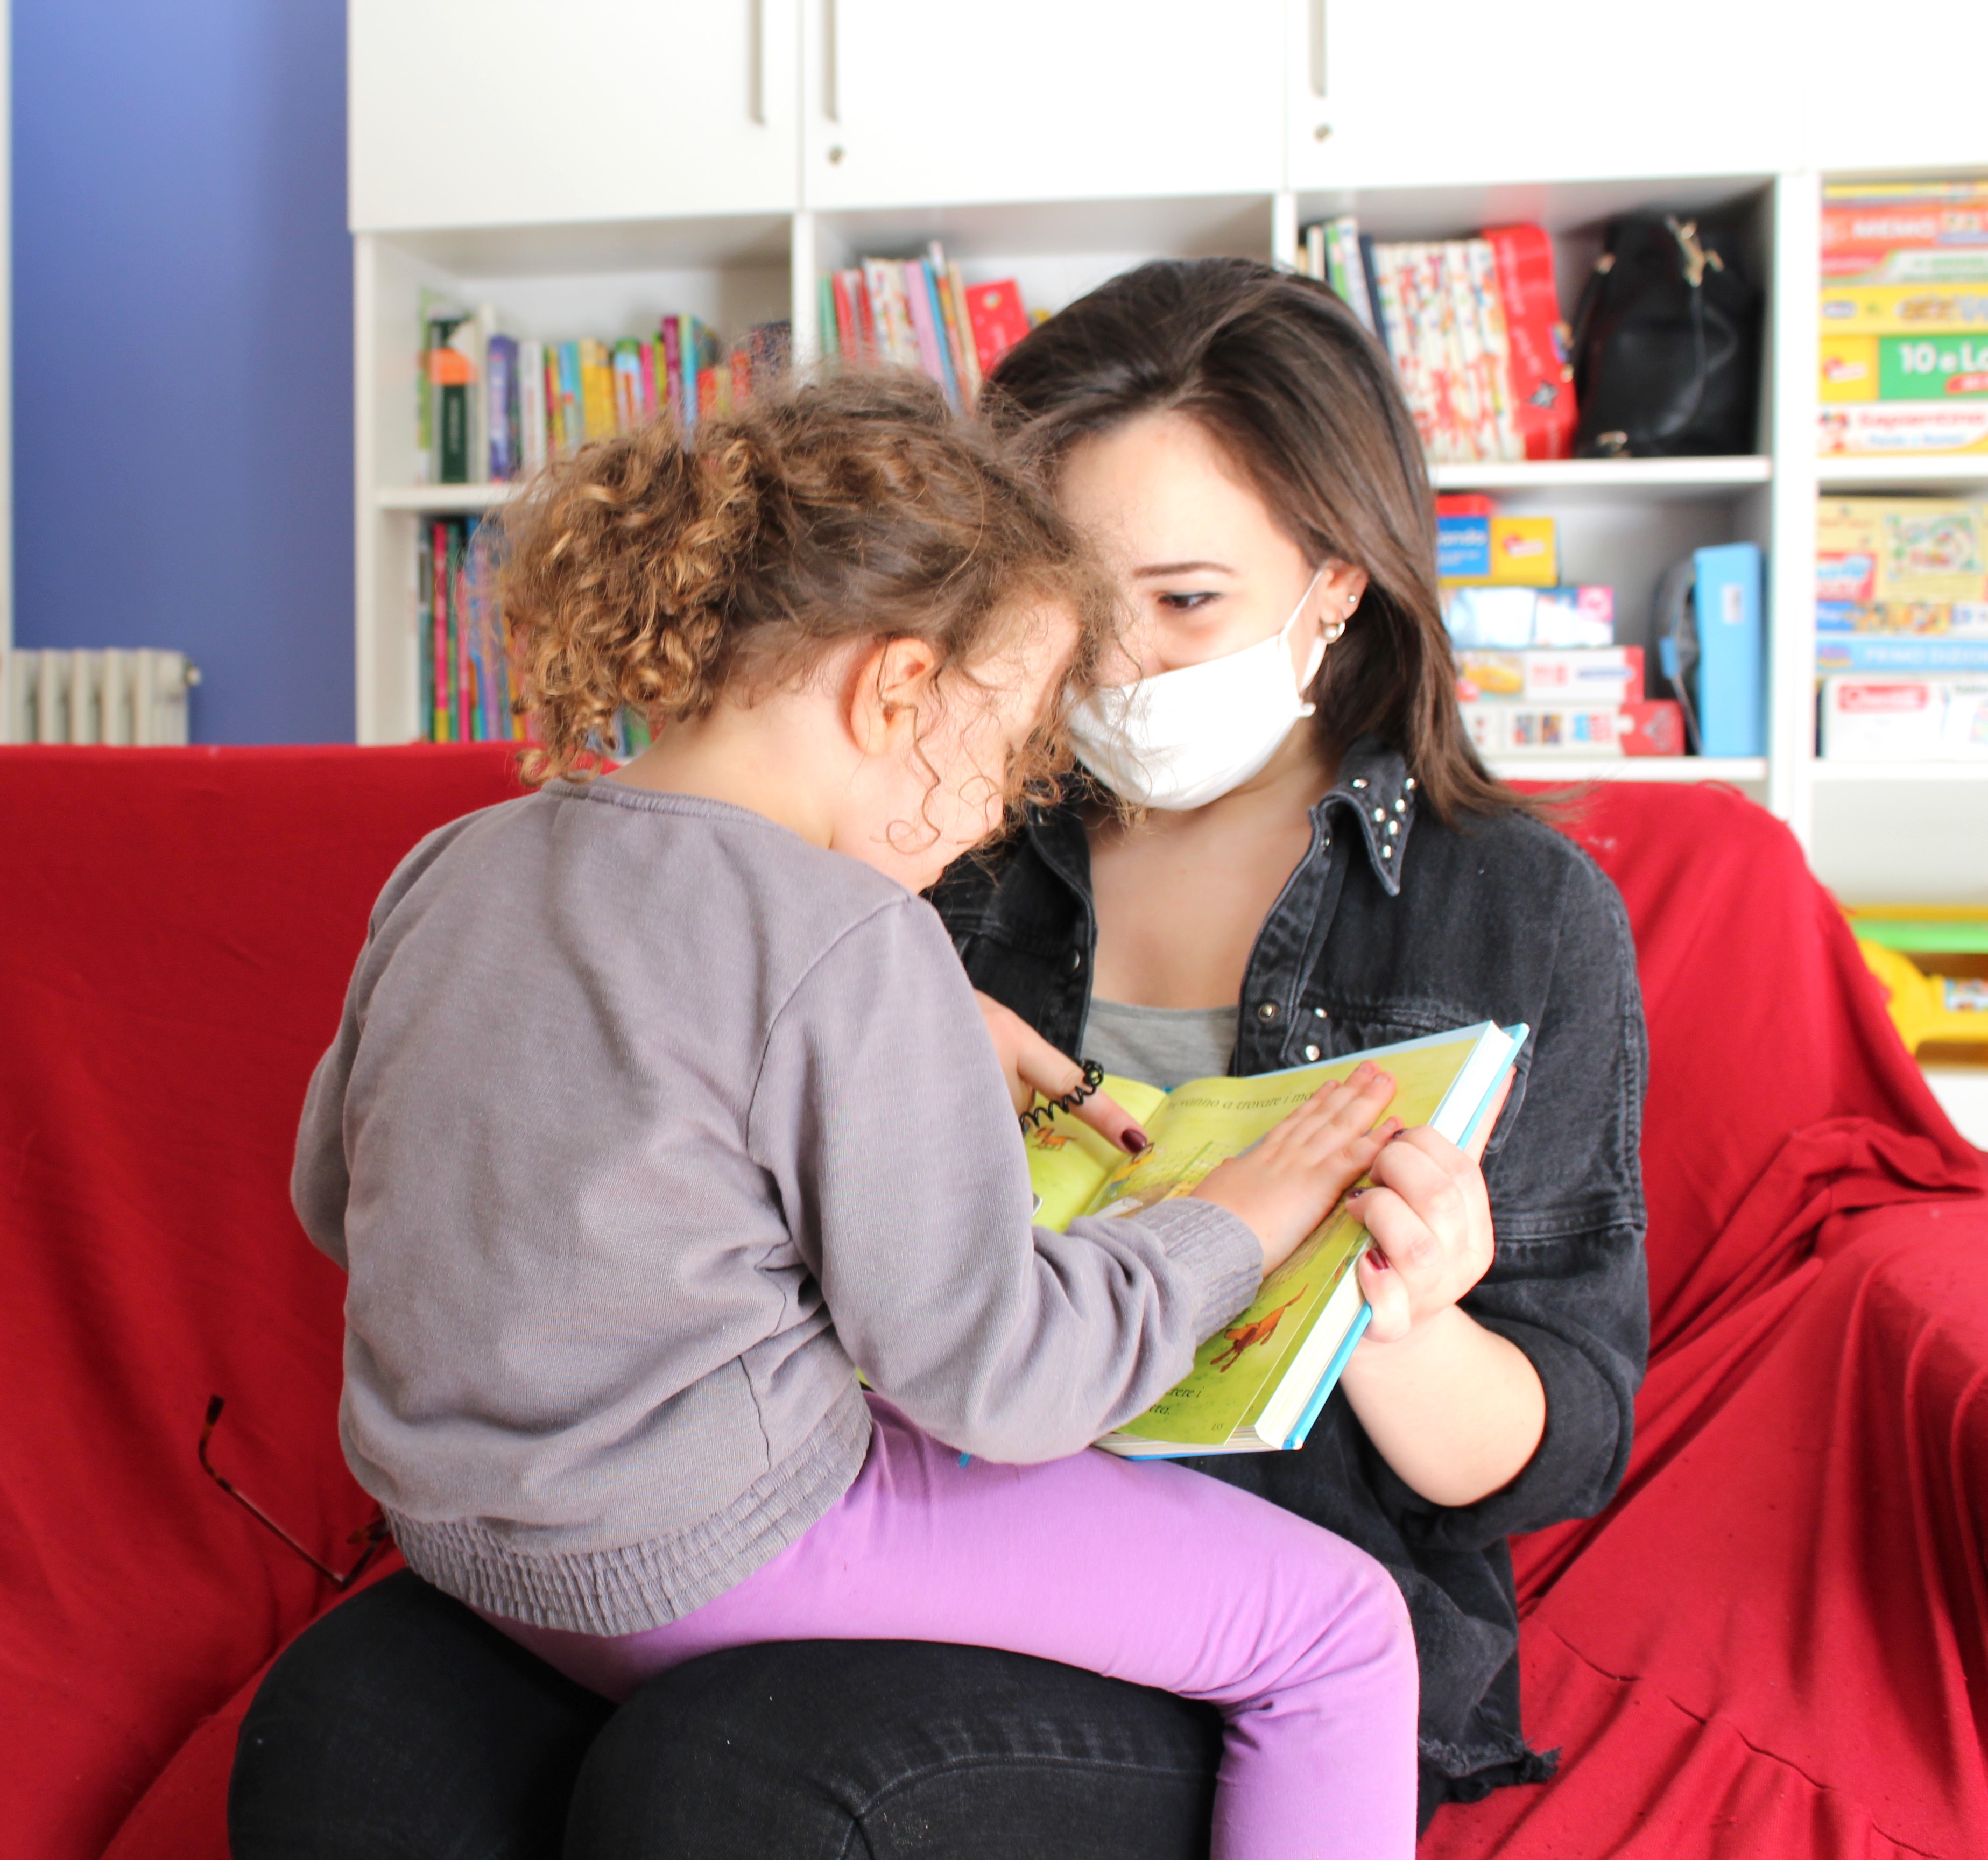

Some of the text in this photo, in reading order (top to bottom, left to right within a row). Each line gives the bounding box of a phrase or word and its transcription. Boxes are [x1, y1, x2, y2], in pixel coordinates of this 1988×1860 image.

[1854, 220, 1934, 239] MEMO
[1899, 342, 1937, 375] 10
[1940, 353, 1958, 372] e
[1181, 1098, 1220, 1108] vanno
[1222, 1102, 1235, 1110] a
[1236, 1097, 1280, 1110] trovare
[1167, 1386, 1205, 1398] rere i
